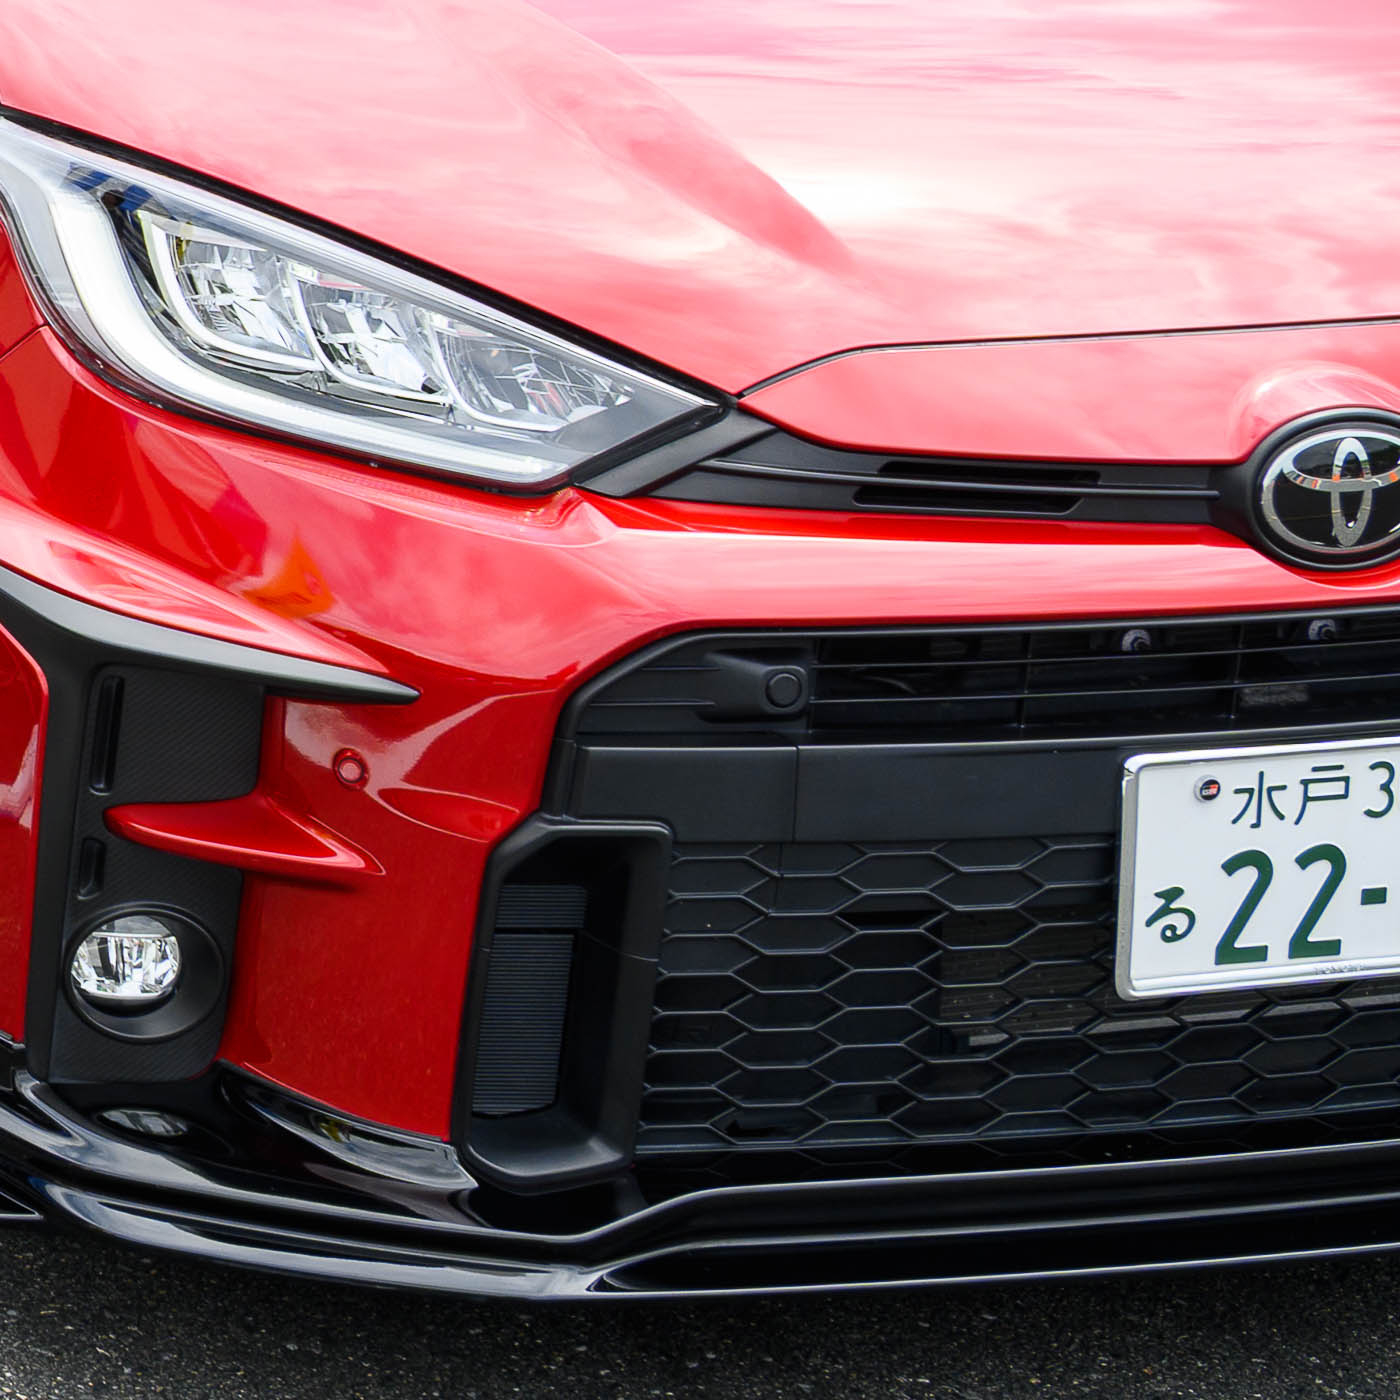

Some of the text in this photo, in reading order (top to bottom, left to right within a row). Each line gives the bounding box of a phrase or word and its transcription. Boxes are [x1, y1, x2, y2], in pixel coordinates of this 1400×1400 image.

[1231, 764, 1351, 830] 水戸
[1144, 843, 1388, 966] る 22-
